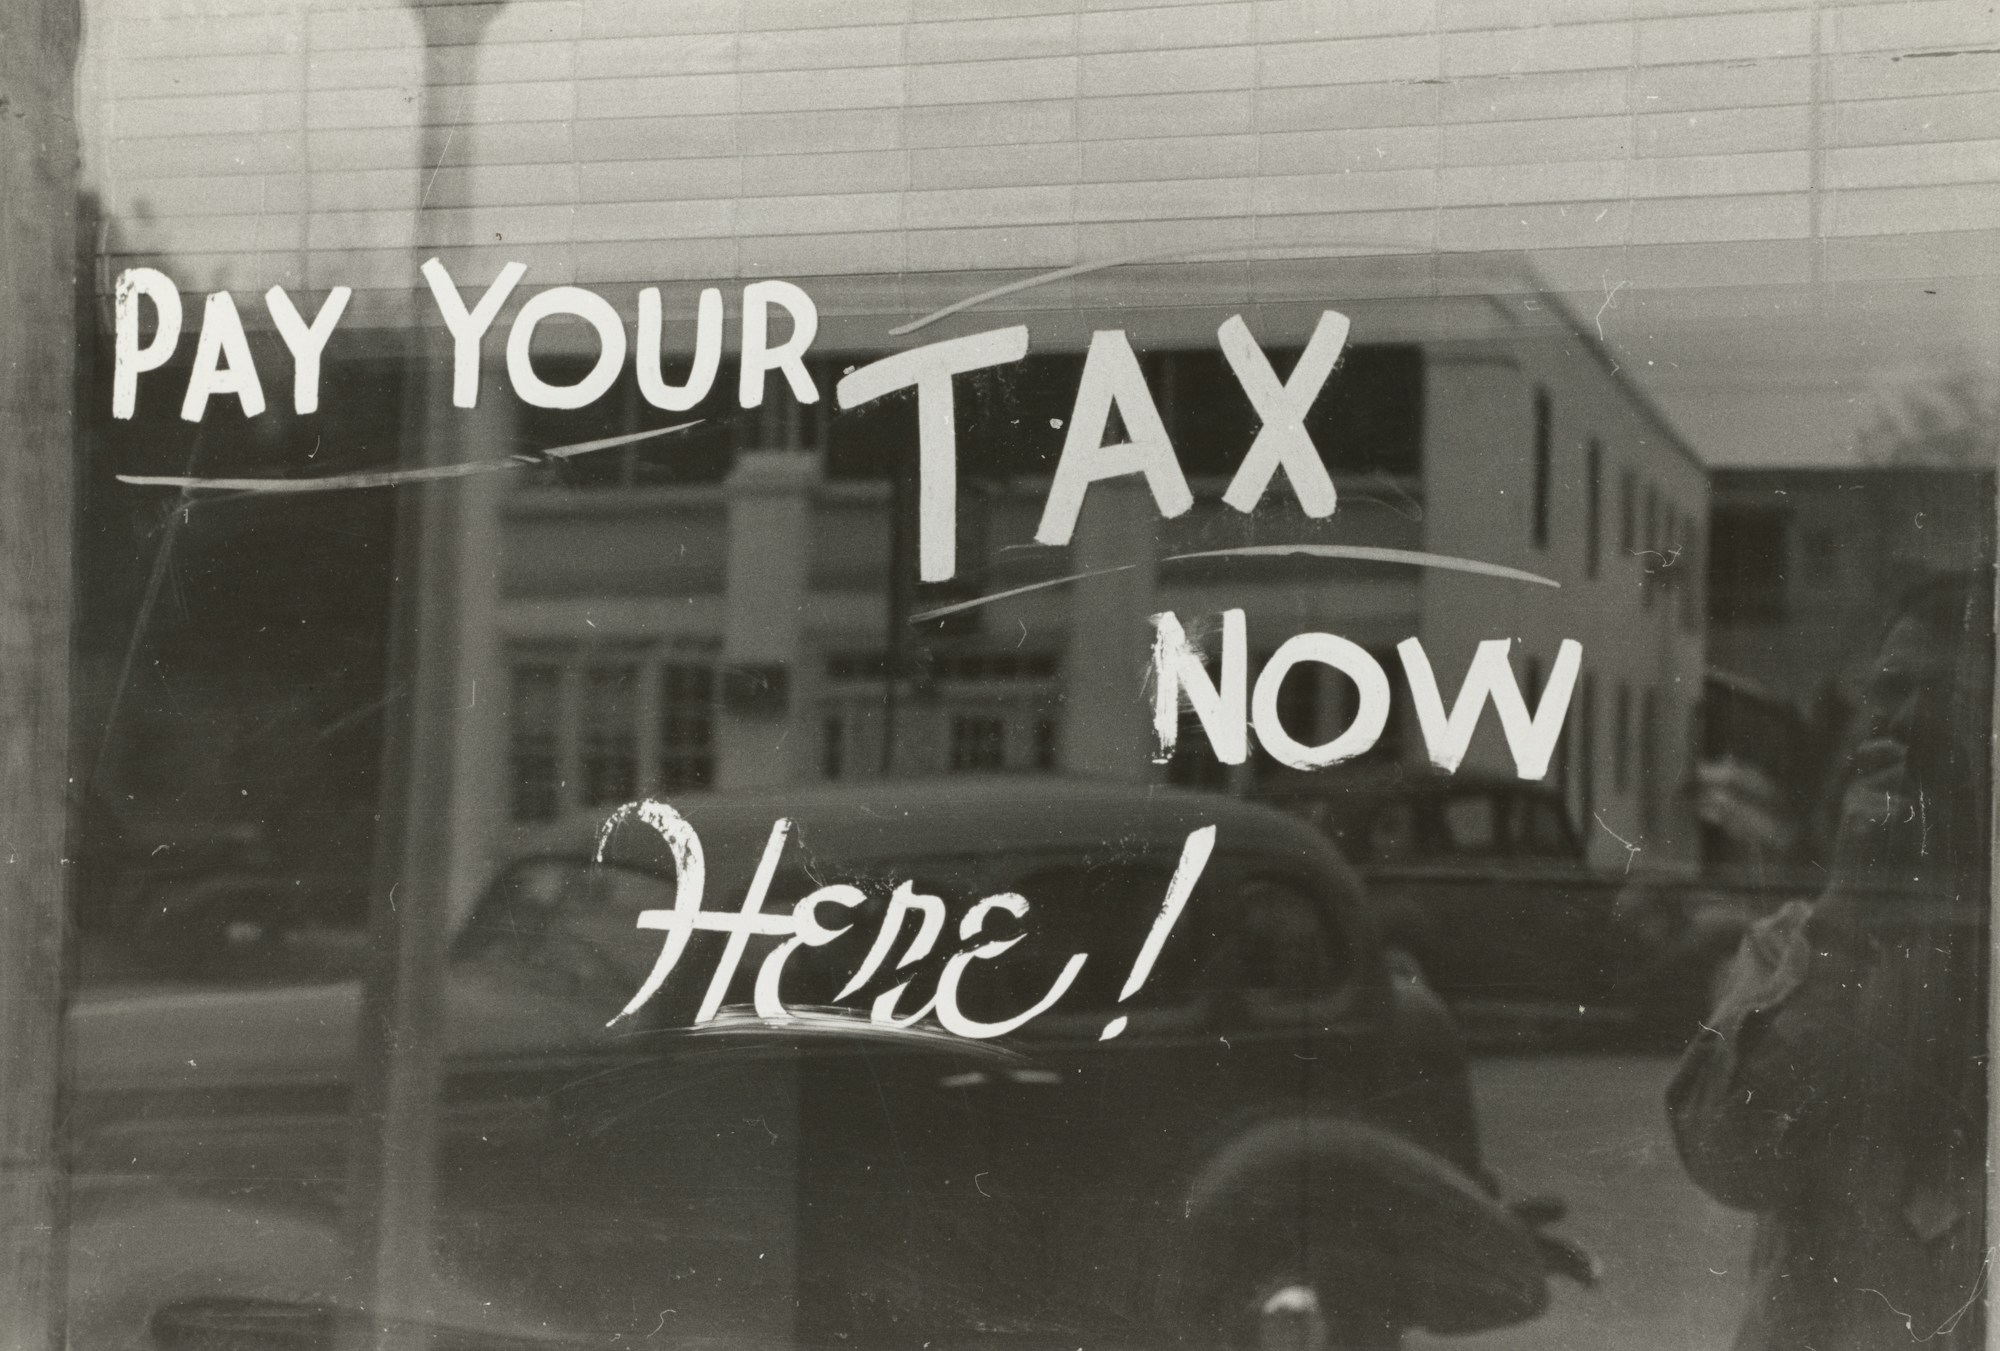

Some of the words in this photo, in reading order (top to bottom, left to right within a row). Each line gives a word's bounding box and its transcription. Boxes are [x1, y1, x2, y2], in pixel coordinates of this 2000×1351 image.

[112, 266, 352, 423] PAY
[420, 256, 820, 411] YOUR
[836, 309, 1350, 583] TAX
[1151, 608, 1583, 780] NOW
